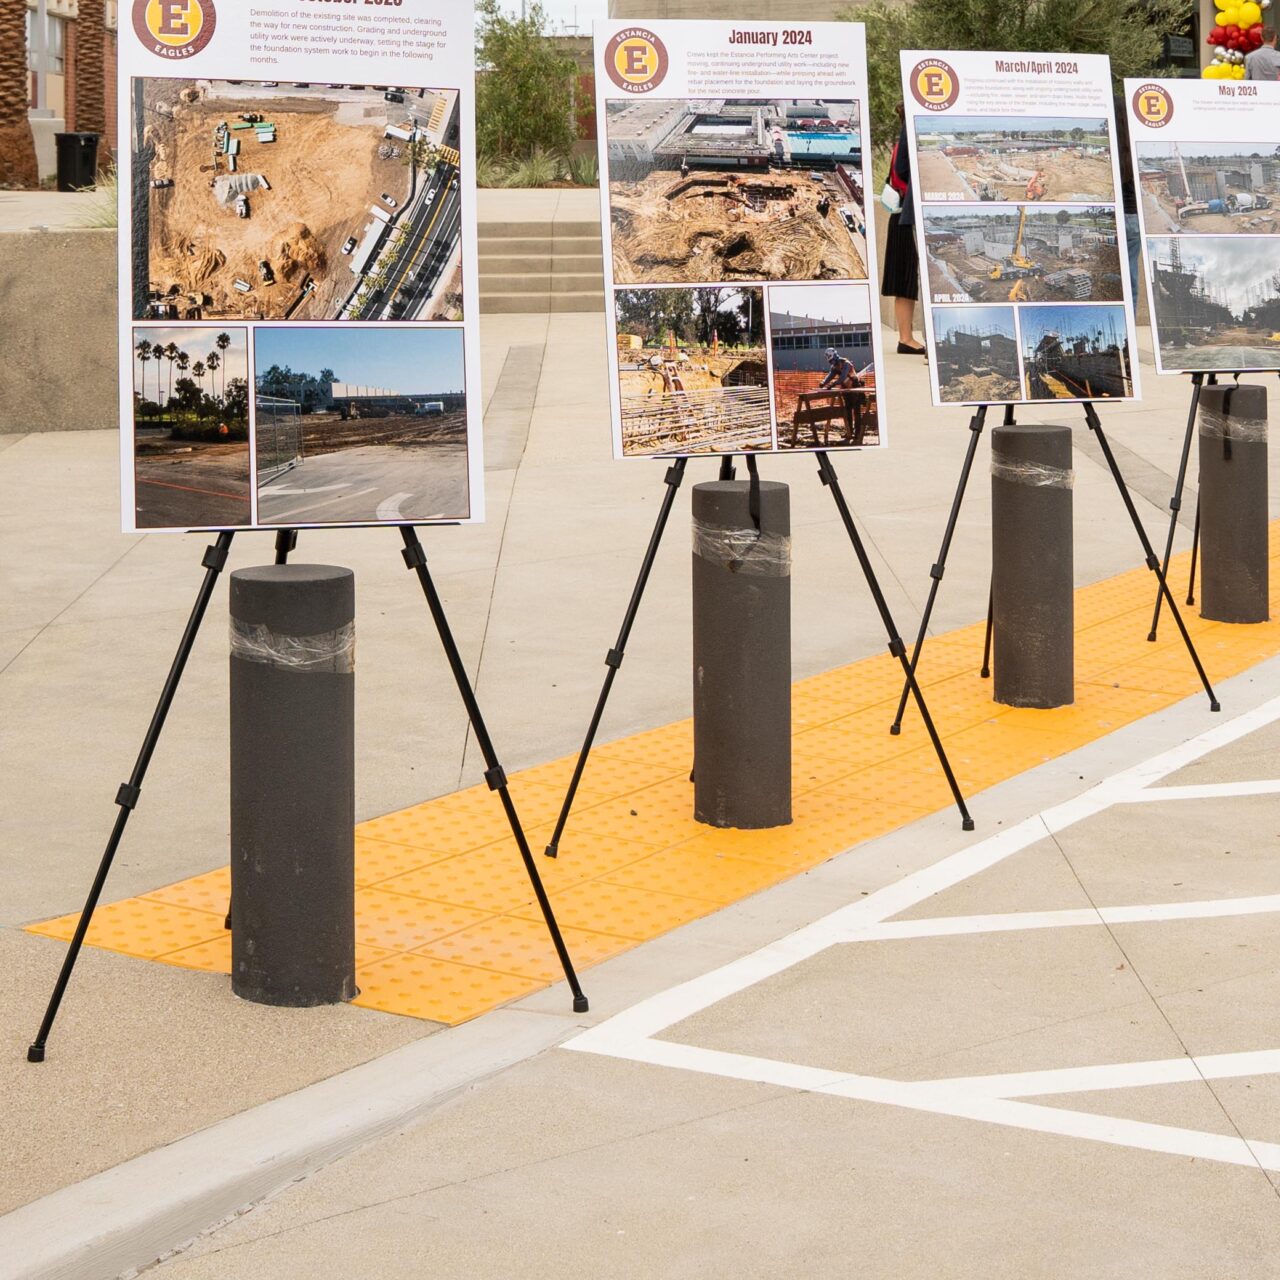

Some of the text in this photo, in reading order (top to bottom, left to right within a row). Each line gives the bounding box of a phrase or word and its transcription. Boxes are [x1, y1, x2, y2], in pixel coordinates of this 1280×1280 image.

[250, 9, 289, 18] Demolition
[300, 11, 311, 19] the
[314, 12, 341, 23] existing
[343, 13, 355, 21] site
[414, 16, 442, 27] clearing
[264, 22, 278, 31] way
[357, 25, 385, 36] Grading
[387, 26, 401, 34] and
[402, 27, 447, 39] underground
[616, 31, 655, 43] ESTANCIA
[729, 30, 813, 46] January 2024
[250, 32, 269, 42] utility
[271, 33, 288, 41] work
[310, 34, 337, 46] actively
[378, 37, 401, 48] setting
[416, 39, 435, 50] stage
[155, 45, 194, 57] EAGLES
[264, 44, 302, 53] foundation
[304, 46, 330, 57] system
[332, 47, 349, 55] work
[360, 48, 379, 59] begin
[402, 50, 433, 61] following
[624, 46, 647, 74] E
[995, 60, 1078, 75] March/April 2024
[622, 82, 653, 92] EAGLES
[925, 73, 943, 95] E
[1218, 86, 1258, 97] May 2024
[1145, 96, 1160, 115] E
